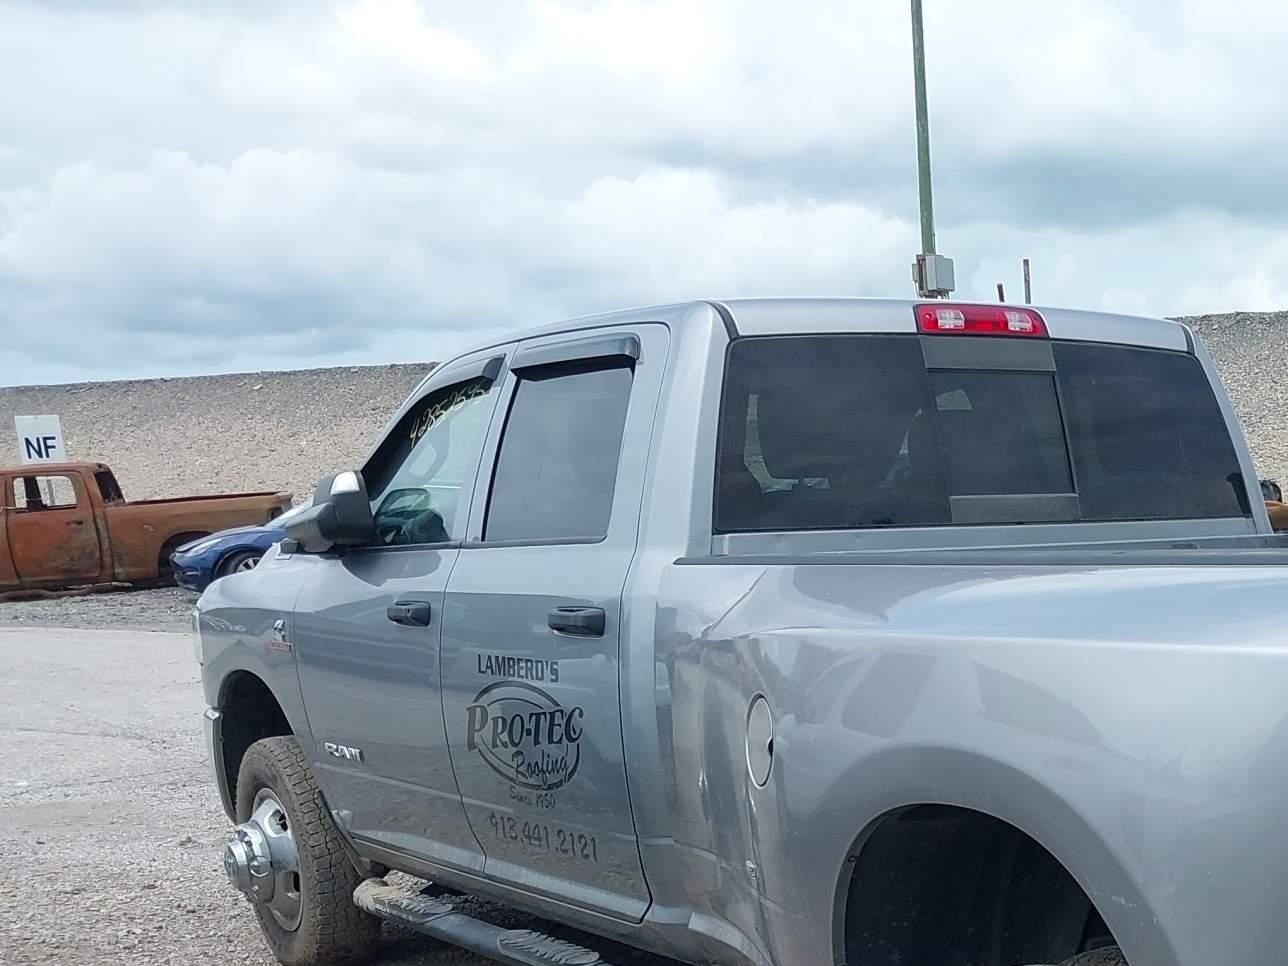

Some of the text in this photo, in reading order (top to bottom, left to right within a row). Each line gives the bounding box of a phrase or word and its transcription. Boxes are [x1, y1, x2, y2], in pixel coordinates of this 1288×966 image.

[24, 436, 56, 459] NF
[477, 653, 560, 683] LAMBERD'S
[466, 706, 584, 752] PRO-TEC
[511, 749, 569, 787] Roofing
[535, 792, 556, 809] 1950
[489, 812, 598, 863] 913.441.2121
